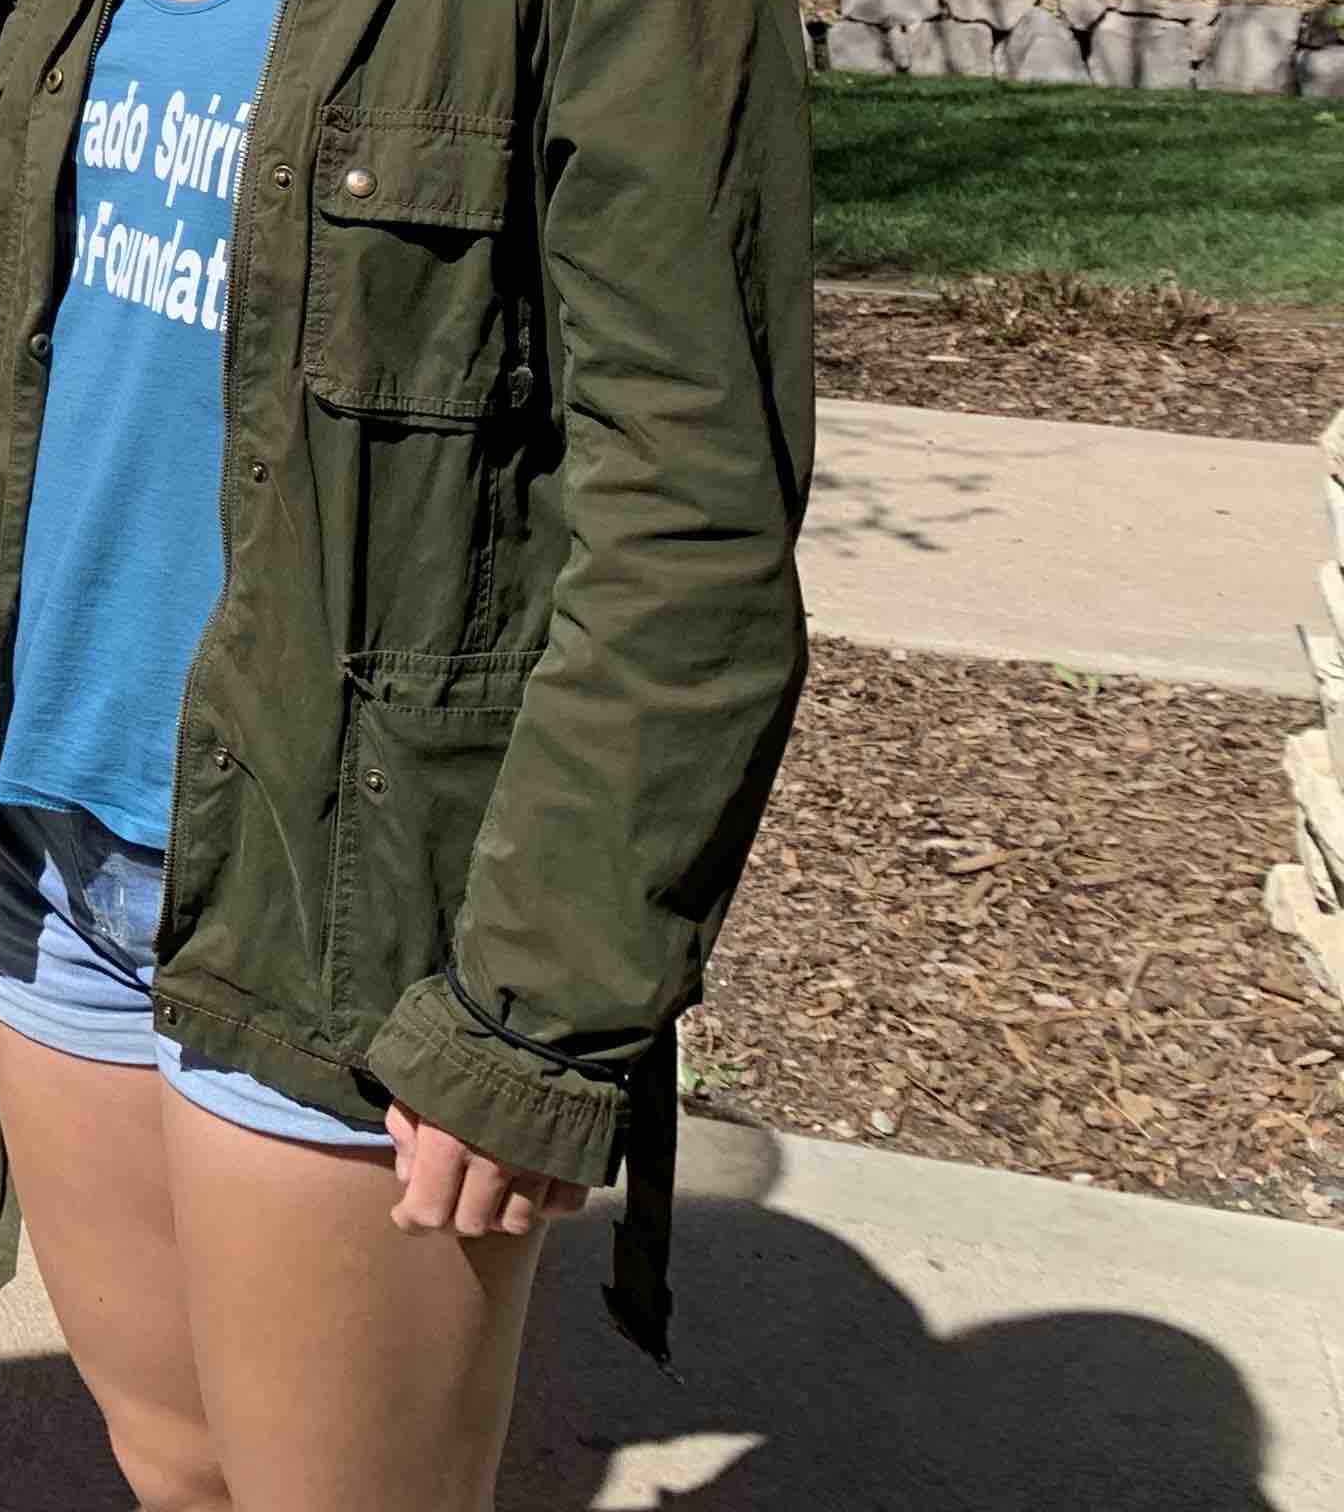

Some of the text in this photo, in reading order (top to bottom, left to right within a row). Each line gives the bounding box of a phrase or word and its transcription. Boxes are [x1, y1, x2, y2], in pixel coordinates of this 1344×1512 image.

[81, 80, 249, 208] ado Spiri
[83, 201, 228, 333] Foundat
